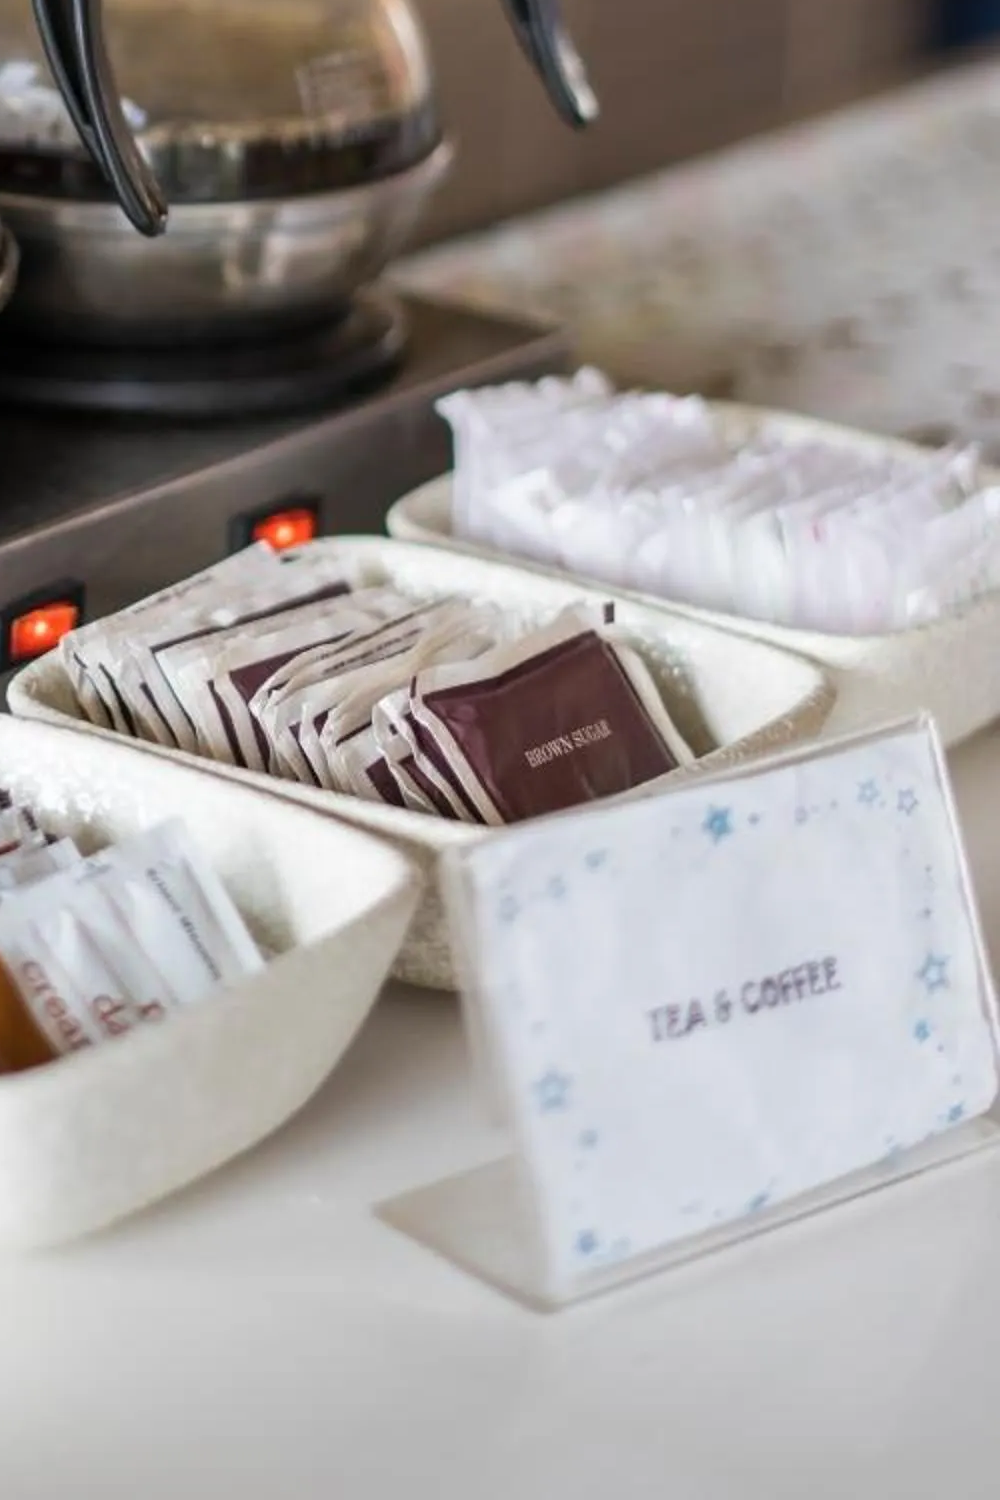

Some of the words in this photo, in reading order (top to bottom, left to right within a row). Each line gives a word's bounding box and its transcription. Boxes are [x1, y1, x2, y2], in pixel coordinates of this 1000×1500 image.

[525, 735, 574, 768] BROWN
[570, 719, 612, 748] SUGAR
[648, 998, 707, 1042] TEA
[741, 956, 840, 1013] COFFEE
